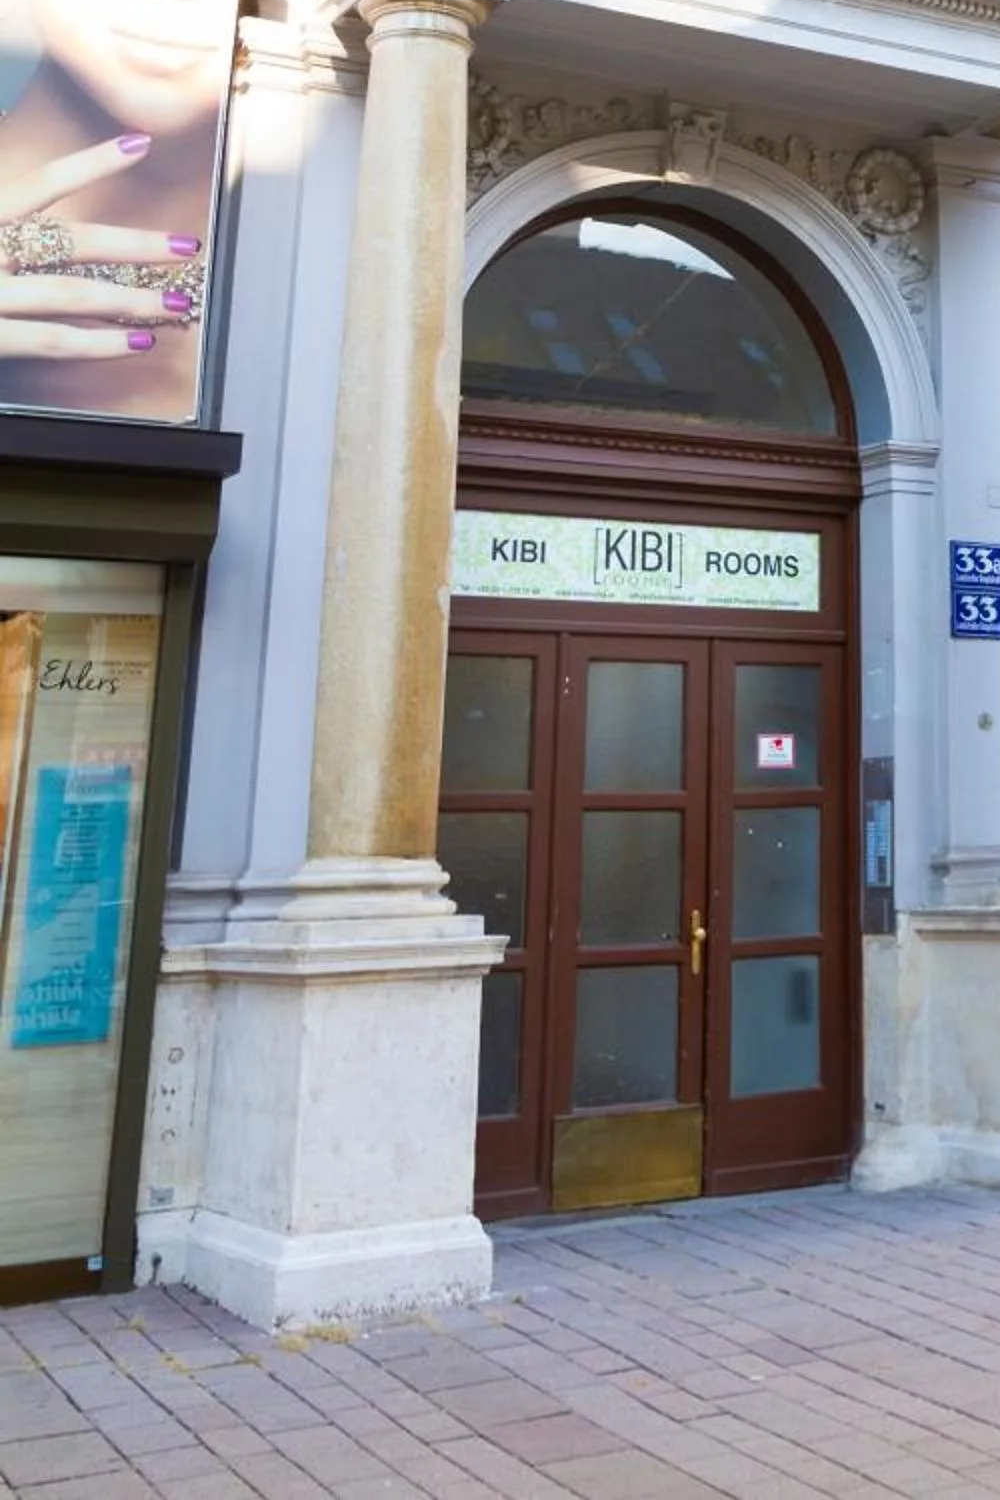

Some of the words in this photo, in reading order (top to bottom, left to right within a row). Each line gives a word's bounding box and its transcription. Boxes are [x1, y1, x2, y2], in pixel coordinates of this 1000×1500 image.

[491, 537, 546, 564] KIBI
[705, 551, 800, 578] ROOMS
[959, 595, 998, 623] 33
[39, 658, 119, 695] Ehlers
